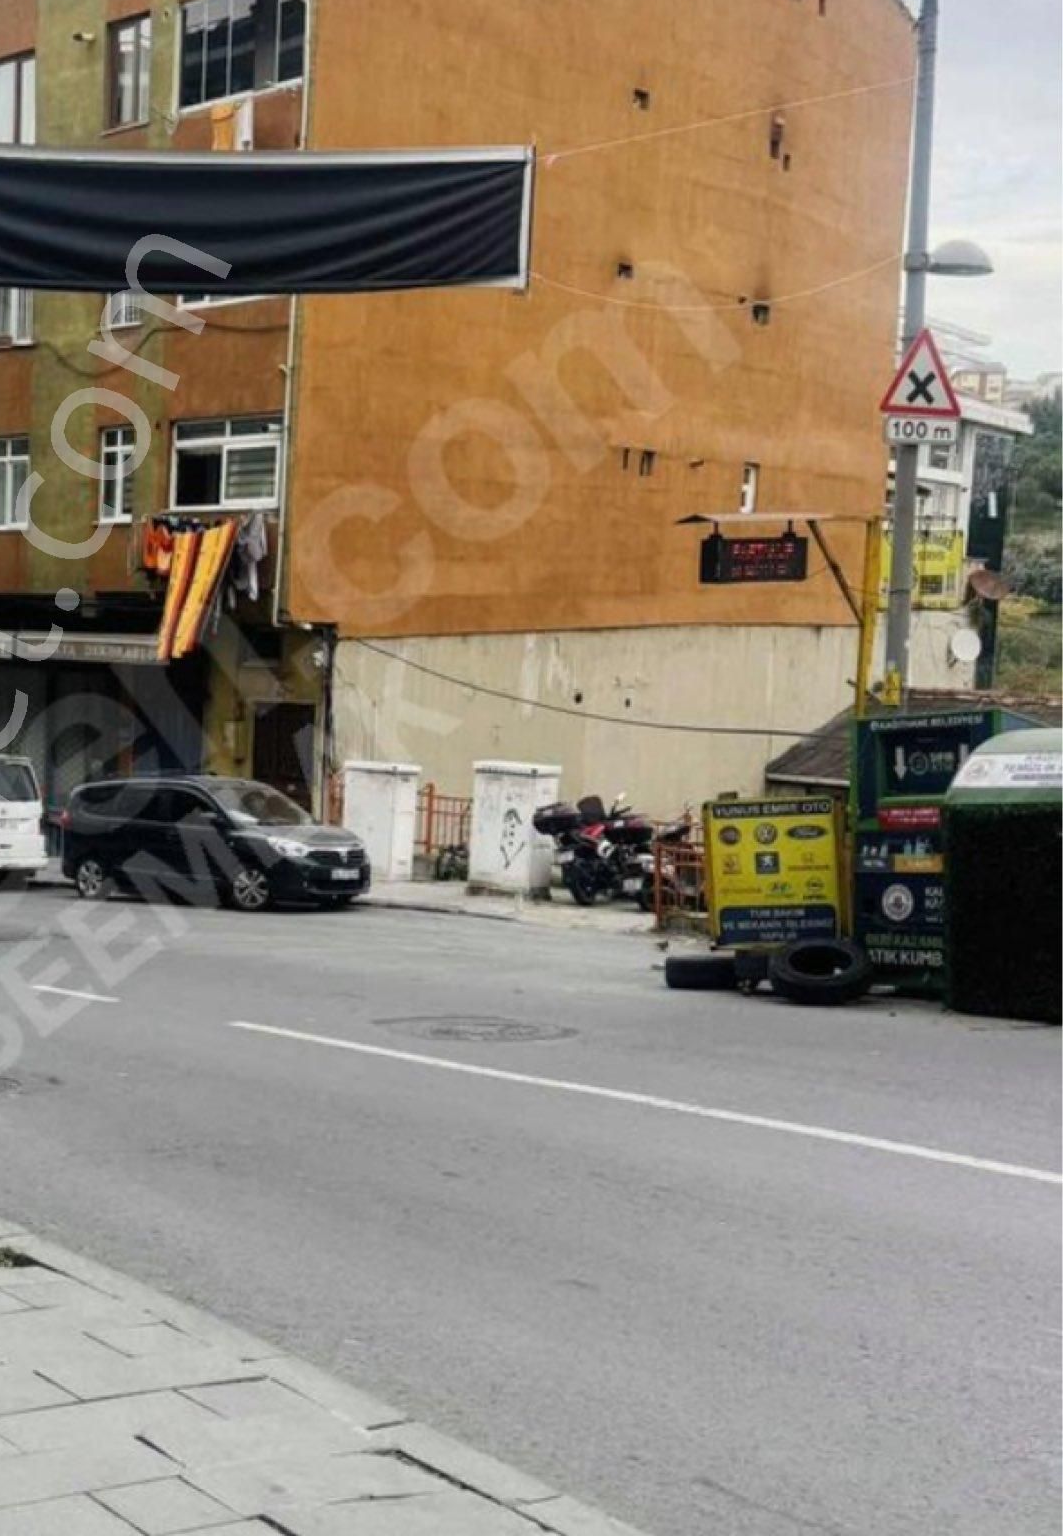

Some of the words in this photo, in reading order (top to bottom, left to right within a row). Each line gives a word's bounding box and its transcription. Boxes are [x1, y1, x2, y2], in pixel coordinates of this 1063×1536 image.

[893, 421, 927, 439] 100
[934, 427, 952, 439] m
[900, 951, 943, 966] KUMB
